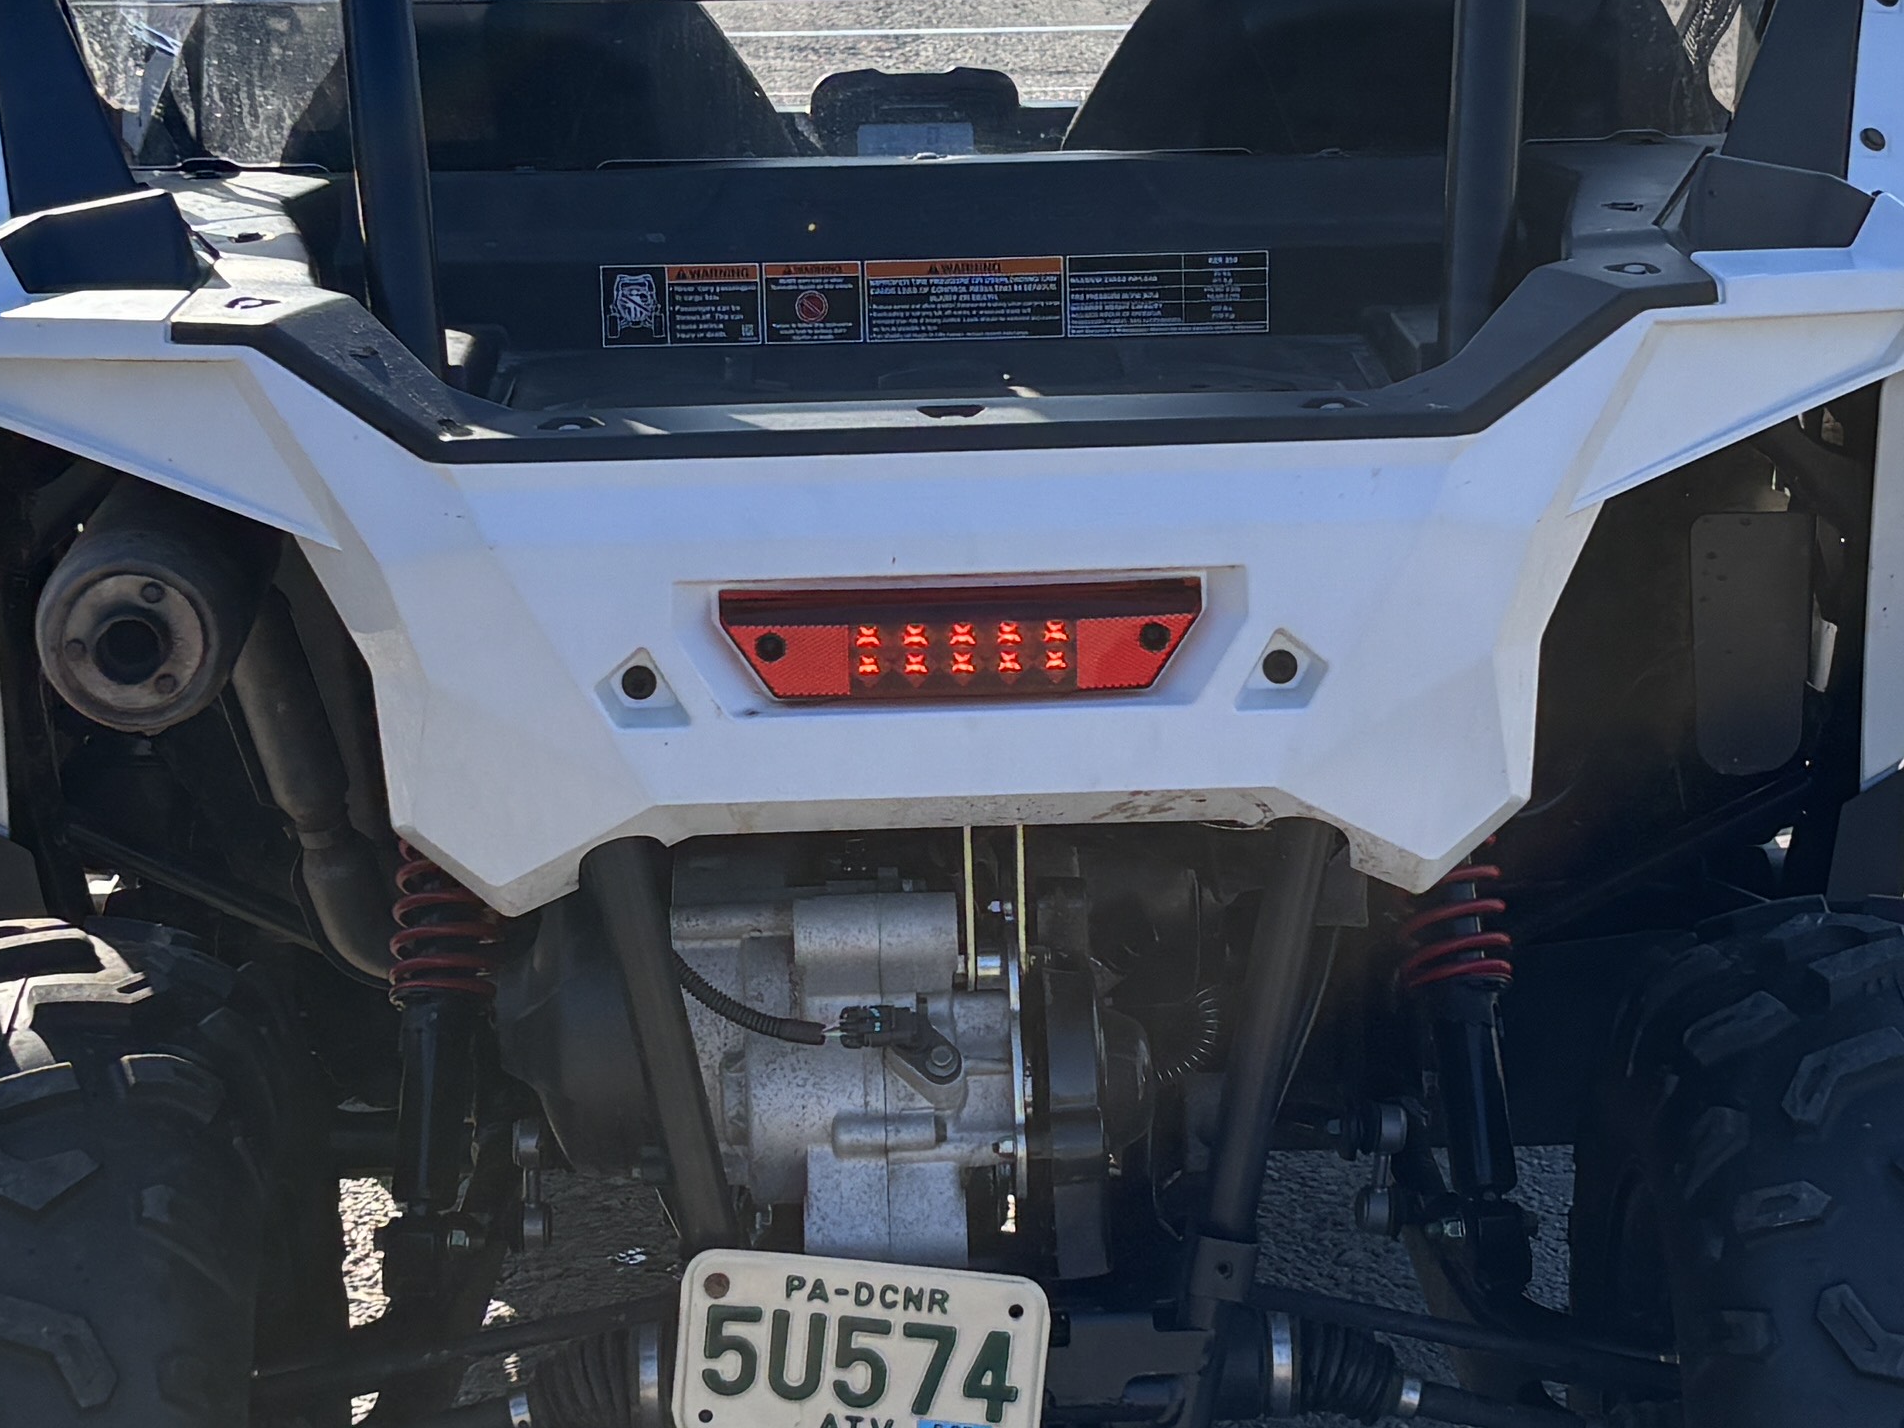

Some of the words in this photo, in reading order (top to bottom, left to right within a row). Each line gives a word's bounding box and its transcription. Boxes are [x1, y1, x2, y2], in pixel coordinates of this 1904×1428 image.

[688, 267, 749, 280] WARNING
[938, 262, 1001, 275] WARNING
[785, 1274, 950, 1314] PA-DCNR
[701, 1304, 1019, 1423] 5U574
